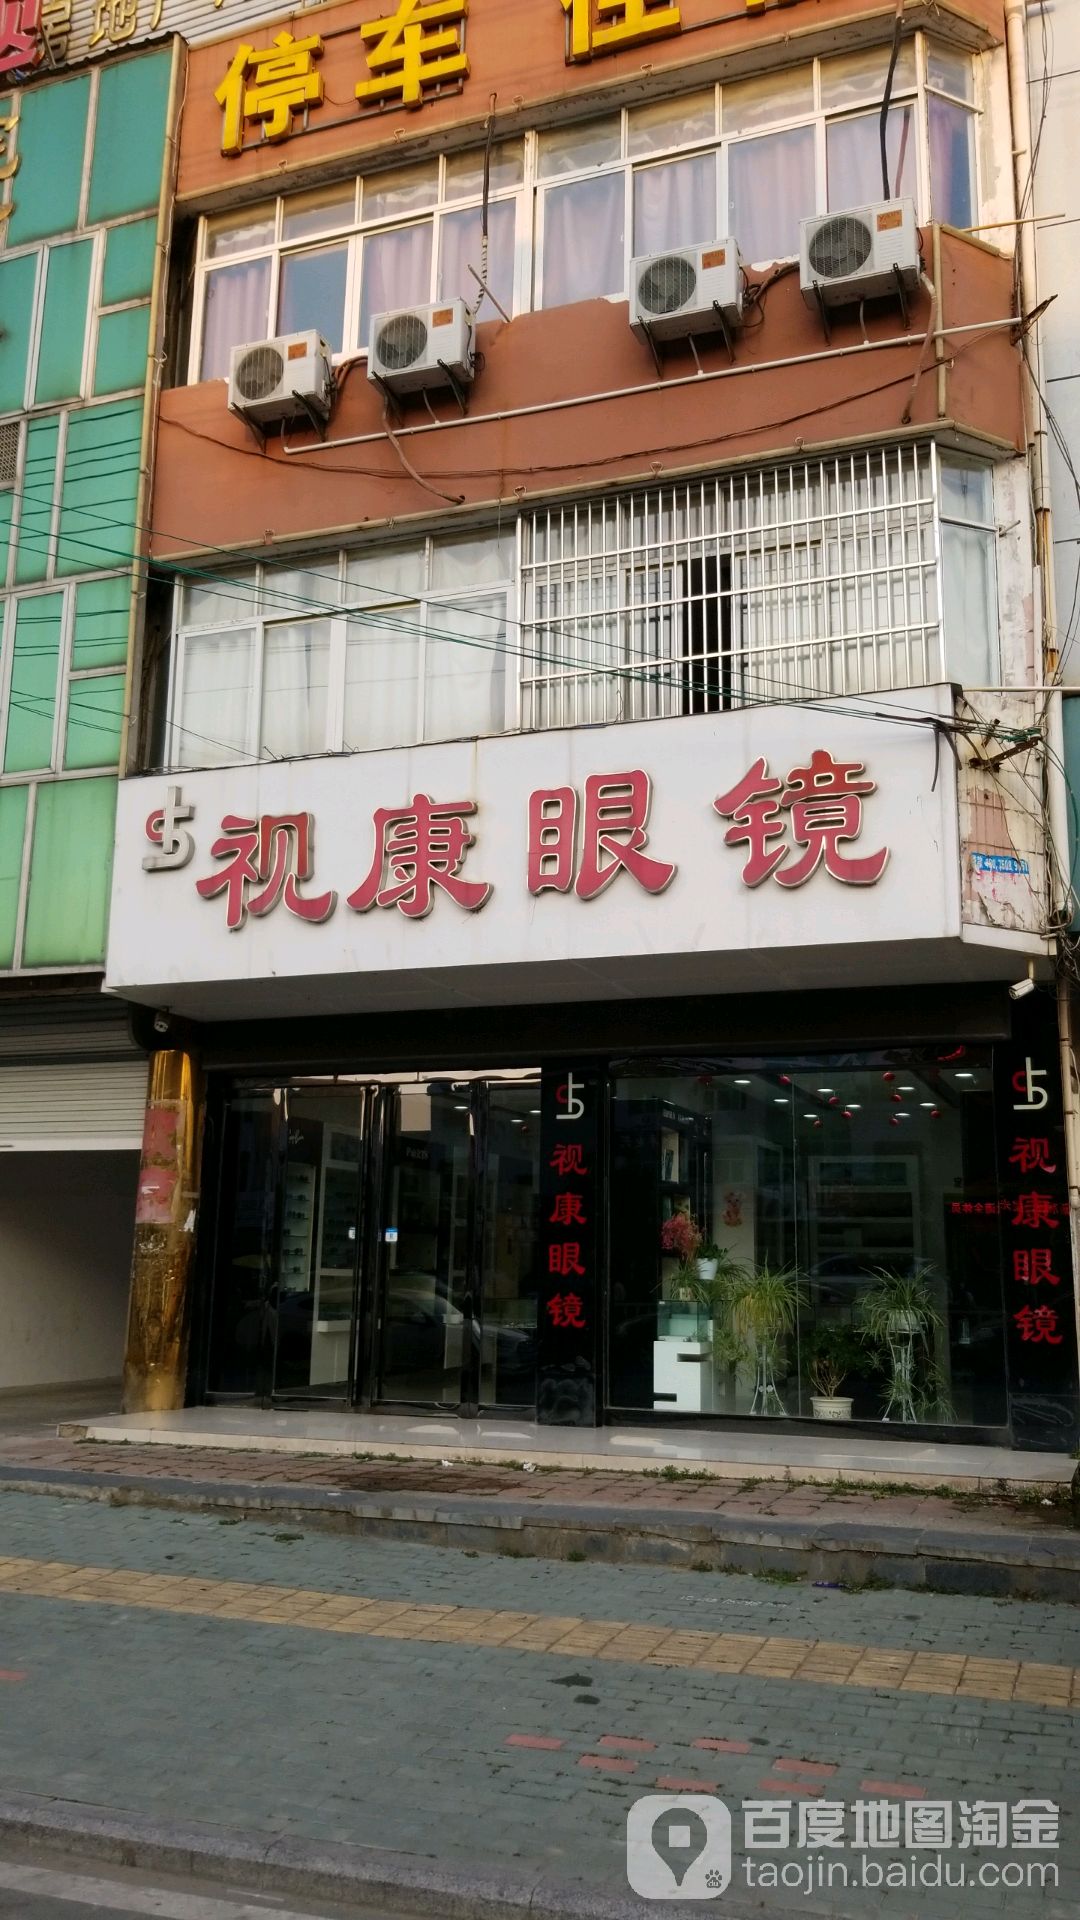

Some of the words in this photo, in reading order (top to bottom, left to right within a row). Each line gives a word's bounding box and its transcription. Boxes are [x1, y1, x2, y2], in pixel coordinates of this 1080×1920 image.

[196, 750, 888, 931] 视康眼镜
[546, 1144, 587, 1329] 视康眼镜
[1007, 1136, 1064, 1346] 视康眼镜
